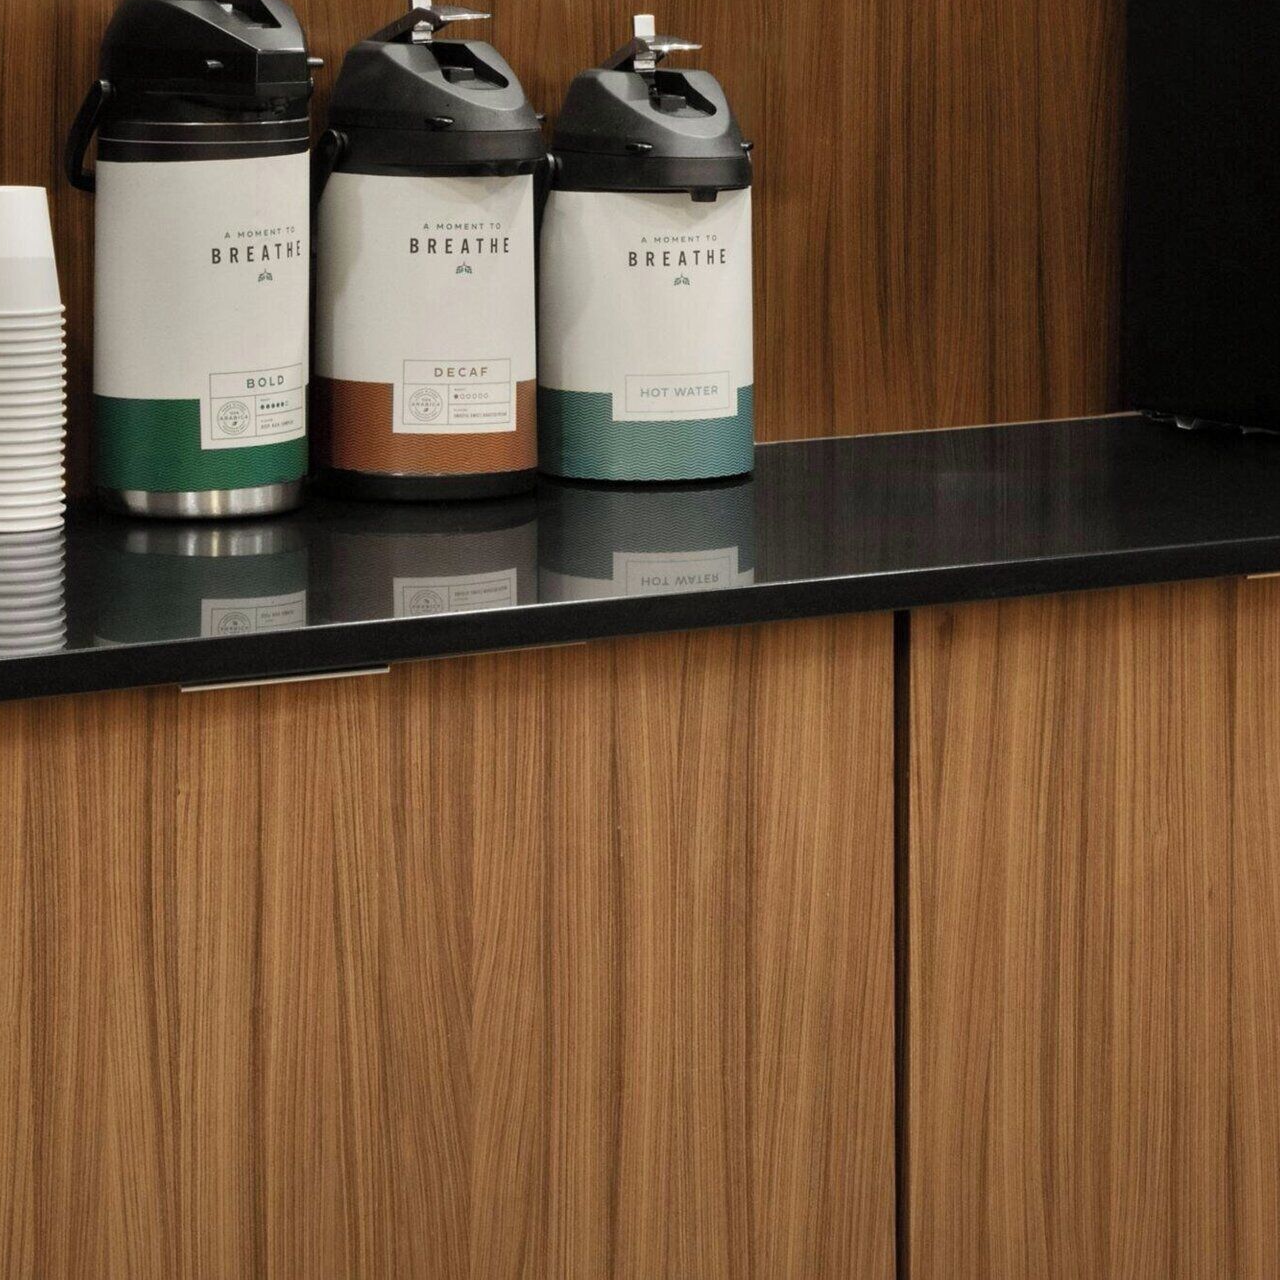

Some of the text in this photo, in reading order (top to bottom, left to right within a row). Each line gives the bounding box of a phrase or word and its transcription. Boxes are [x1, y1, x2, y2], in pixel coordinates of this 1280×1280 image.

[224, 226, 295, 239] A MOMENT TO
[490, 222, 502, 230] TO
[409, 237, 510, 254] BREATHE
[653, 235, 700, 243] MOMENT
[211, 239, 301, 265] BREATHE
[628, 248, 726, 267] BREATHE
[434, 367, 488, 378] DECAF
[246, 375, 284, 389] BOLD
[640, 385, 719, 398] HOT WATER
